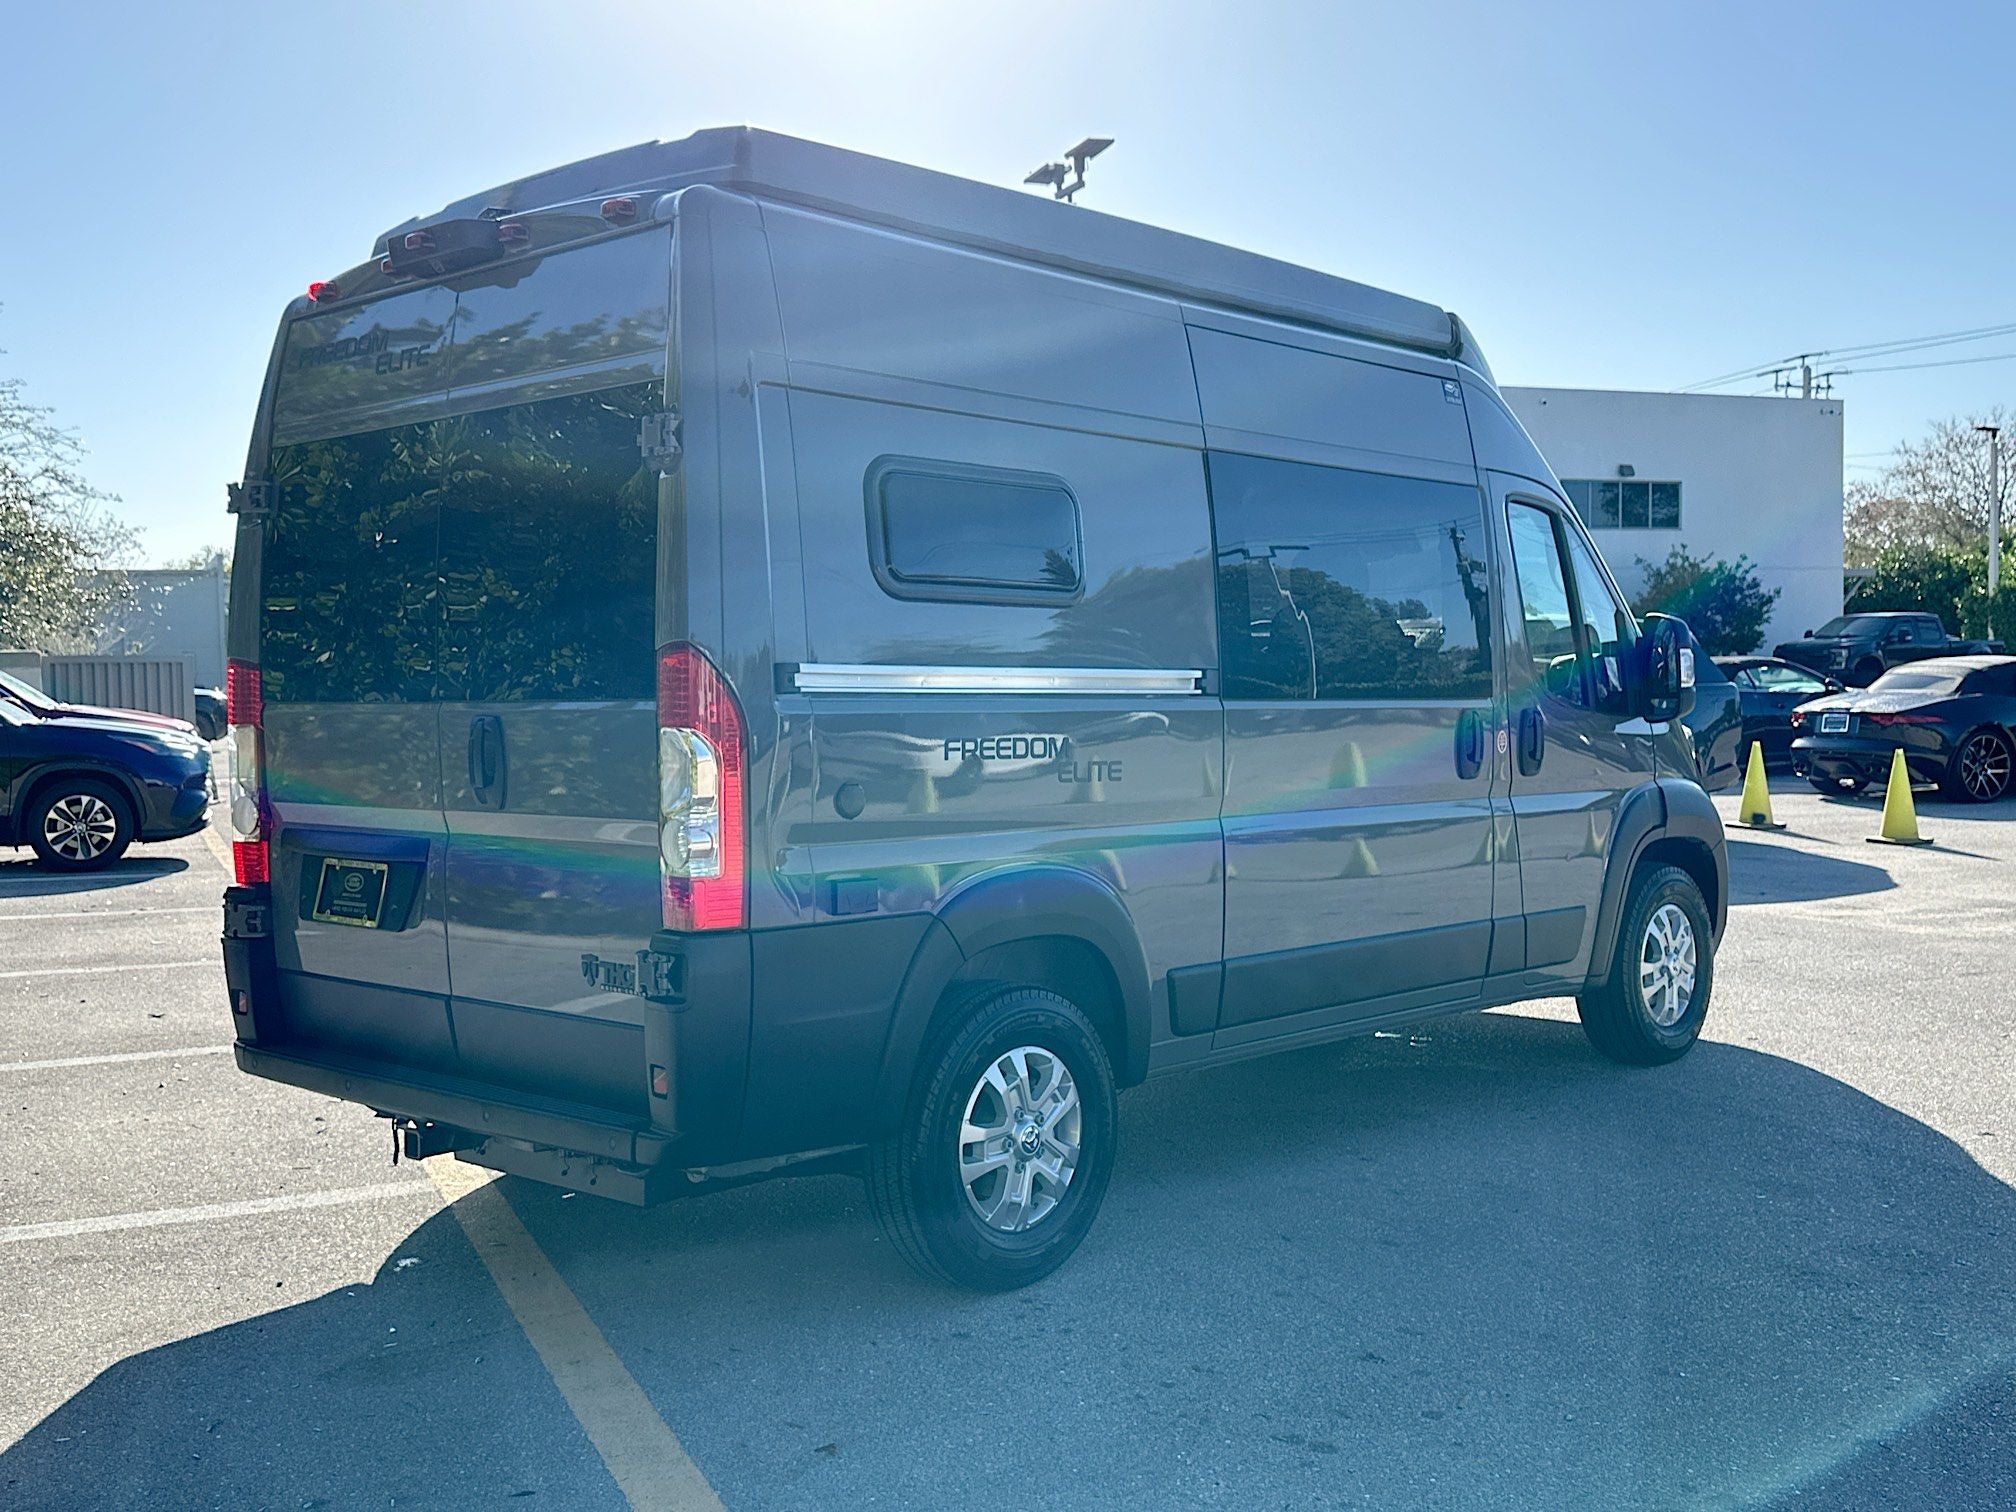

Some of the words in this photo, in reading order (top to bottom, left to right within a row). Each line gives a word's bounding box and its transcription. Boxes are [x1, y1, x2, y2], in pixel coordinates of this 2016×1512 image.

[299, 329, 389, 368] FREEDOM
[376, 344, 430, 375] ELITE
[944, 737, 1069, 760] FREEDOM
[1058, 760, 1122, 783] ELITE
